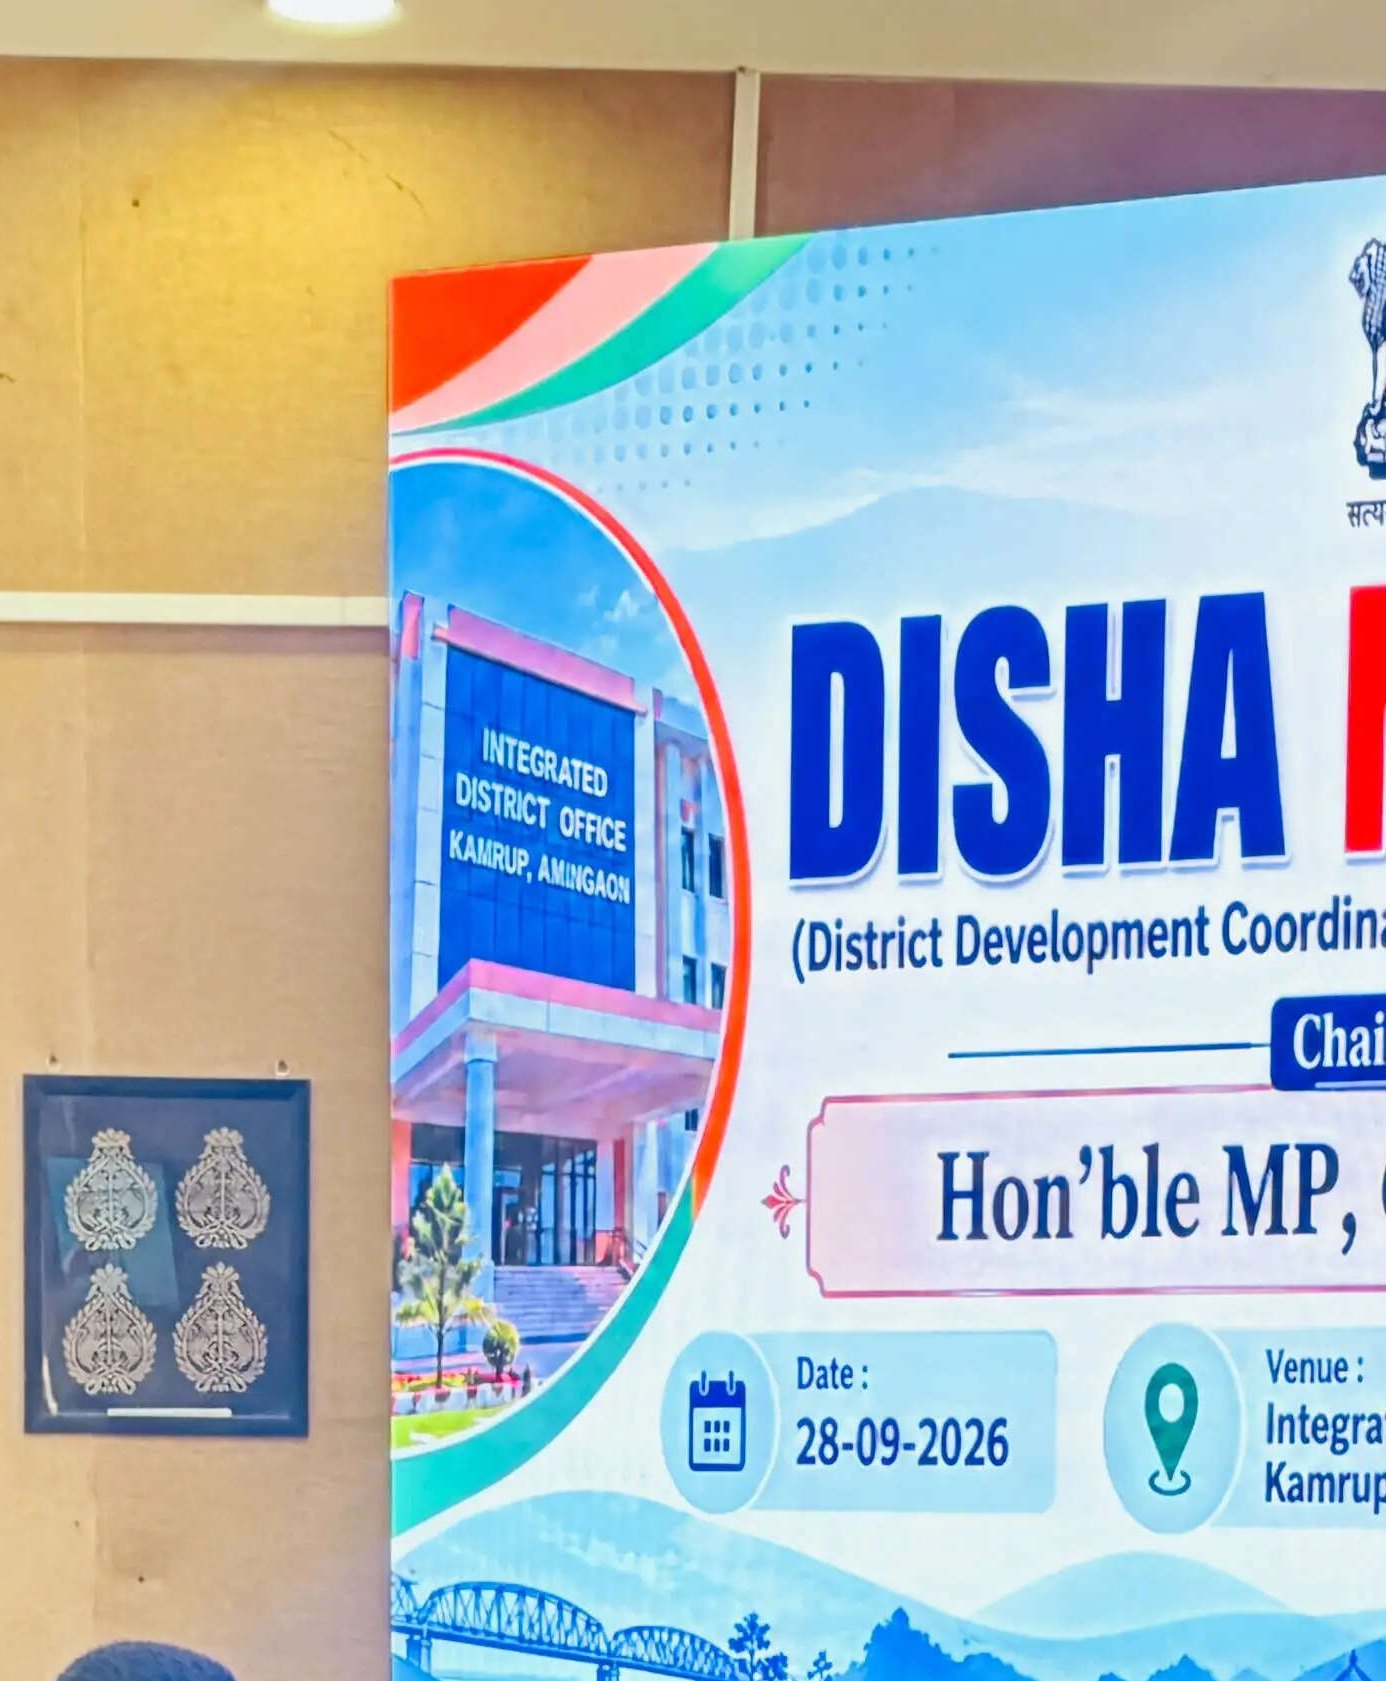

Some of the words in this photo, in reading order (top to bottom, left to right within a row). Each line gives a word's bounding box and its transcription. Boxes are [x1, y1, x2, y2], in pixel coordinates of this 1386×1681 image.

[482, 727, 608, 797] INTEGRATED
[790, 593, 1284, 878] DISHA
[455, 772, 550, 829] DISTRICT
[559, 806, 627, 852] OFFICE
[449, 829, 532, 884] KAMRUP,
[537, 853, 631, 905] AMINGAON
[793, 917, 942, 984] (District
[957, 906, 1209, 974] Development
[938, 1143, 1199, 1240] Hon’ble
[1222, 1144, 1356, 1255] MP,
[798, 1357, 853, 1389] Date
[1267, 1350, 1348, 1383] Venue
[797, 1417, 1008, 1466] 28-09-2026
